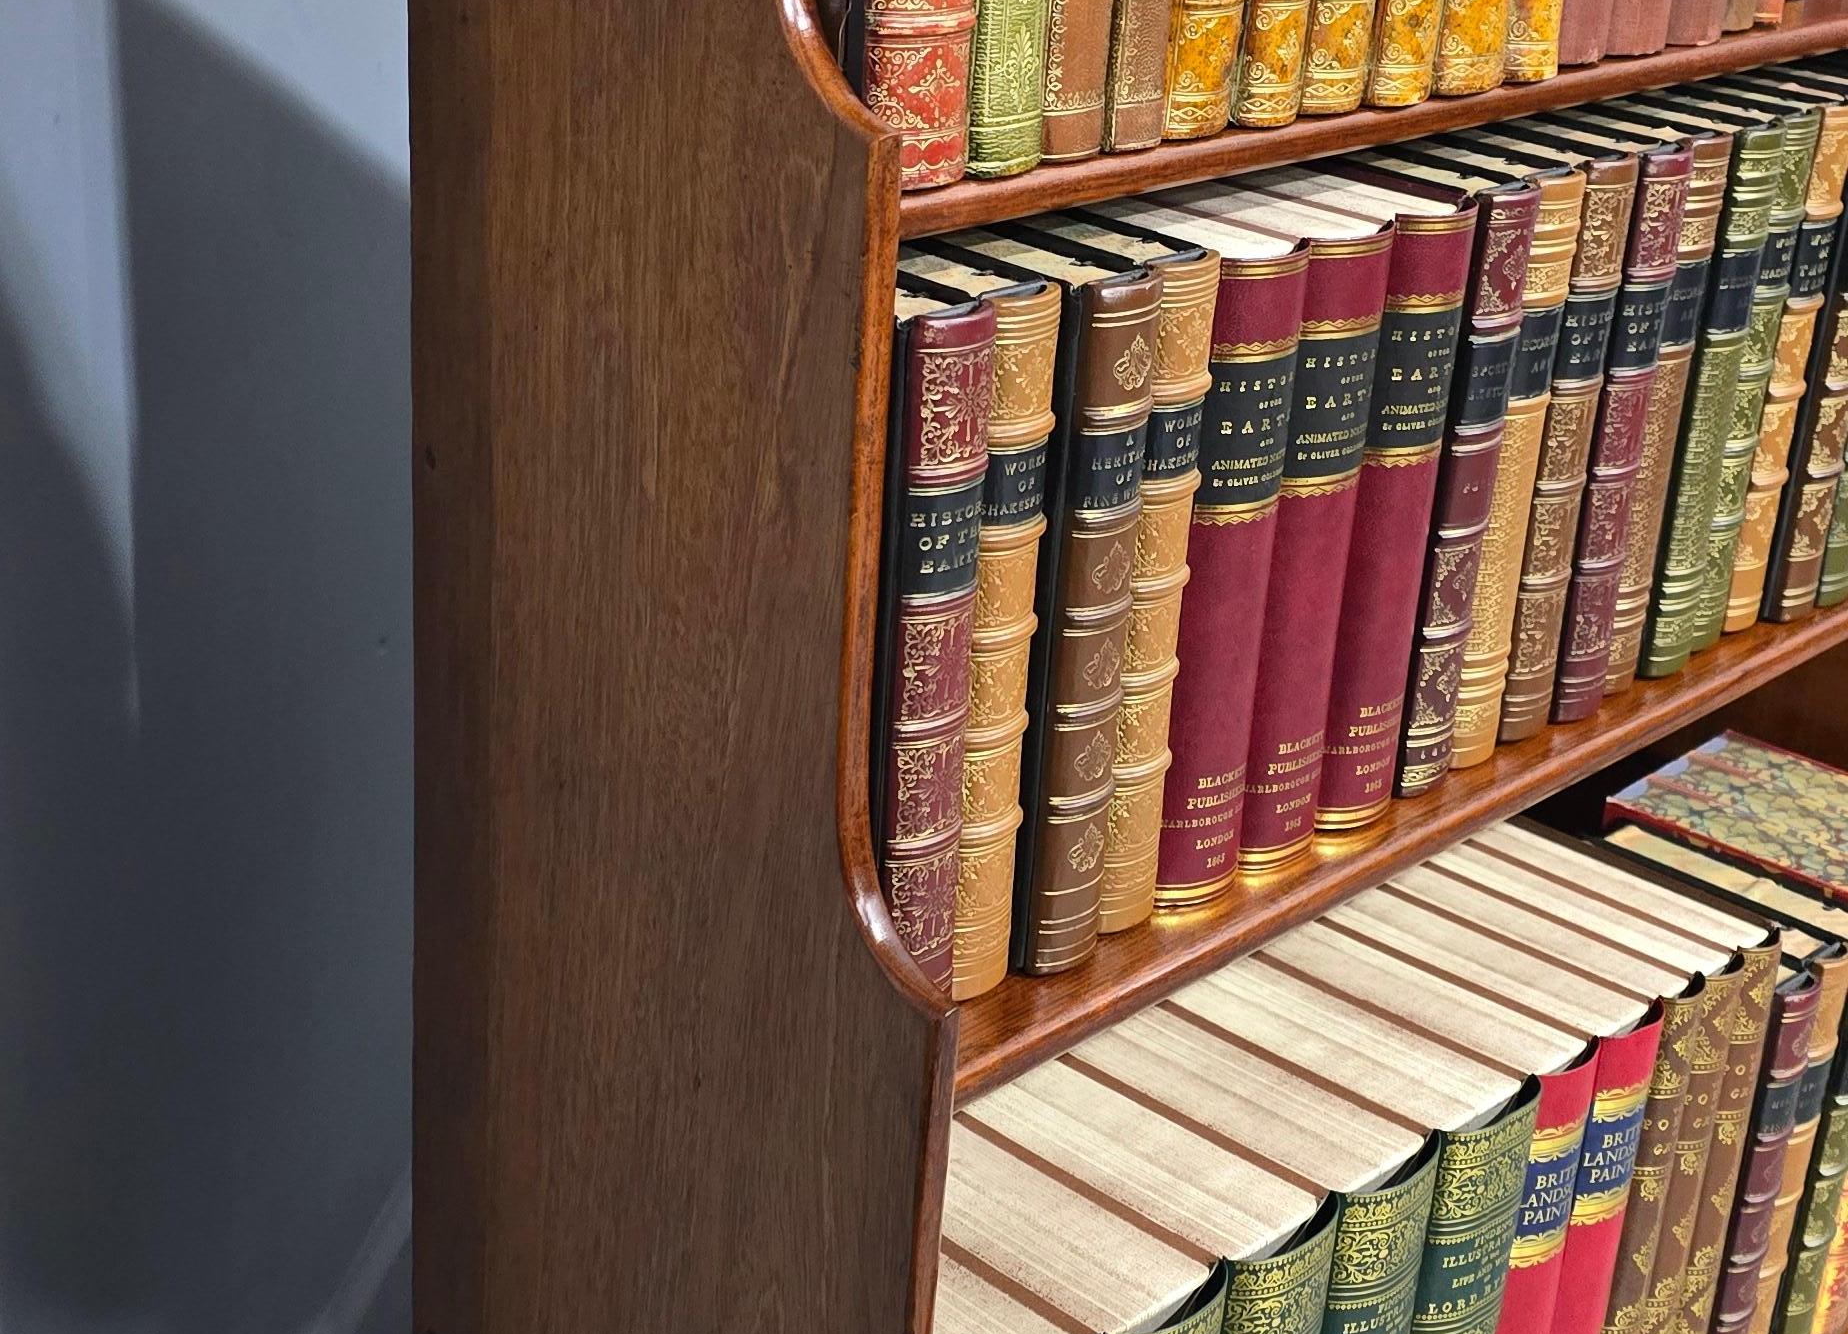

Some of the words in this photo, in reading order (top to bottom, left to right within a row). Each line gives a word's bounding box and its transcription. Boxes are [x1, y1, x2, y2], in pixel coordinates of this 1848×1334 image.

[1125, 434, 1135, 447] A
[1175, 432, 1192, 449] OF
[1115, 469, 1133, 485] OF
[1017, 479, 1036, 493] OF
[918, 534, 951, 552] OF
[1355, 755, 1392, 776] LONDON
[1275, 792, 1312, 815] LONDON
[1195, 828, 1234, 851] LONDON
[1451, 1273, 1475, 1289] LIFE
[1428, 1293, 1478, 1315] LORD
